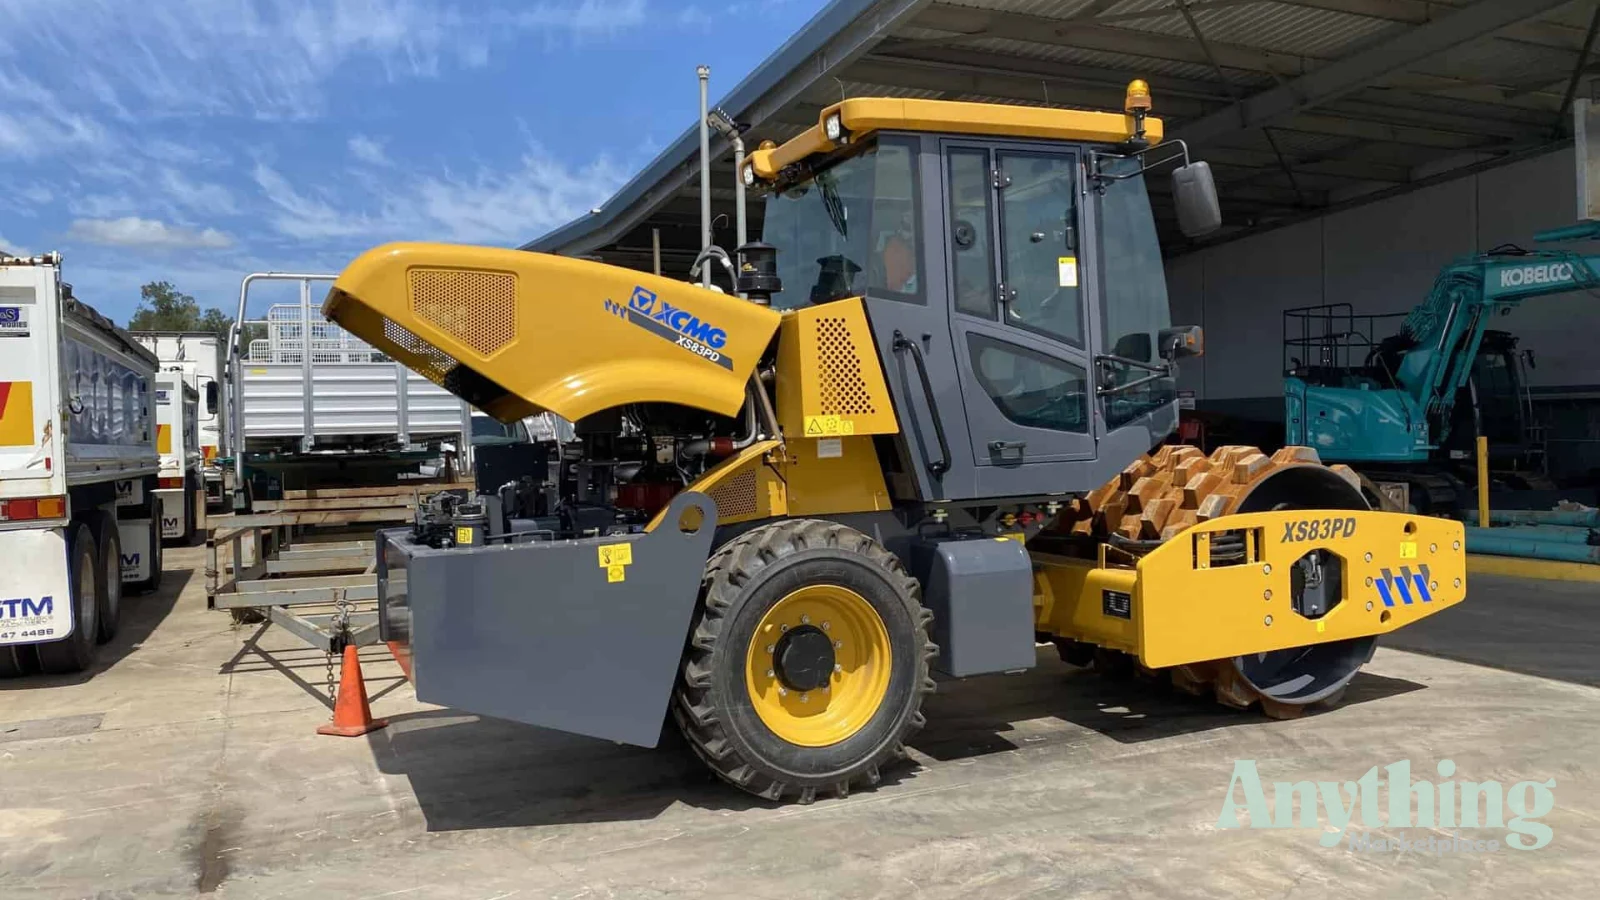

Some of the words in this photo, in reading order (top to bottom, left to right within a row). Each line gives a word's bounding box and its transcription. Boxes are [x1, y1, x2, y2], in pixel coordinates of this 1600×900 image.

[1500, 263, 1573, 287] KOBELCO
[652, 301, 727, 349] XCMG
[675, 335, 720, 362] XS83PD
[1281, 517, 1356, 543] XS83PD
[0, 595, 53, 618] TM
